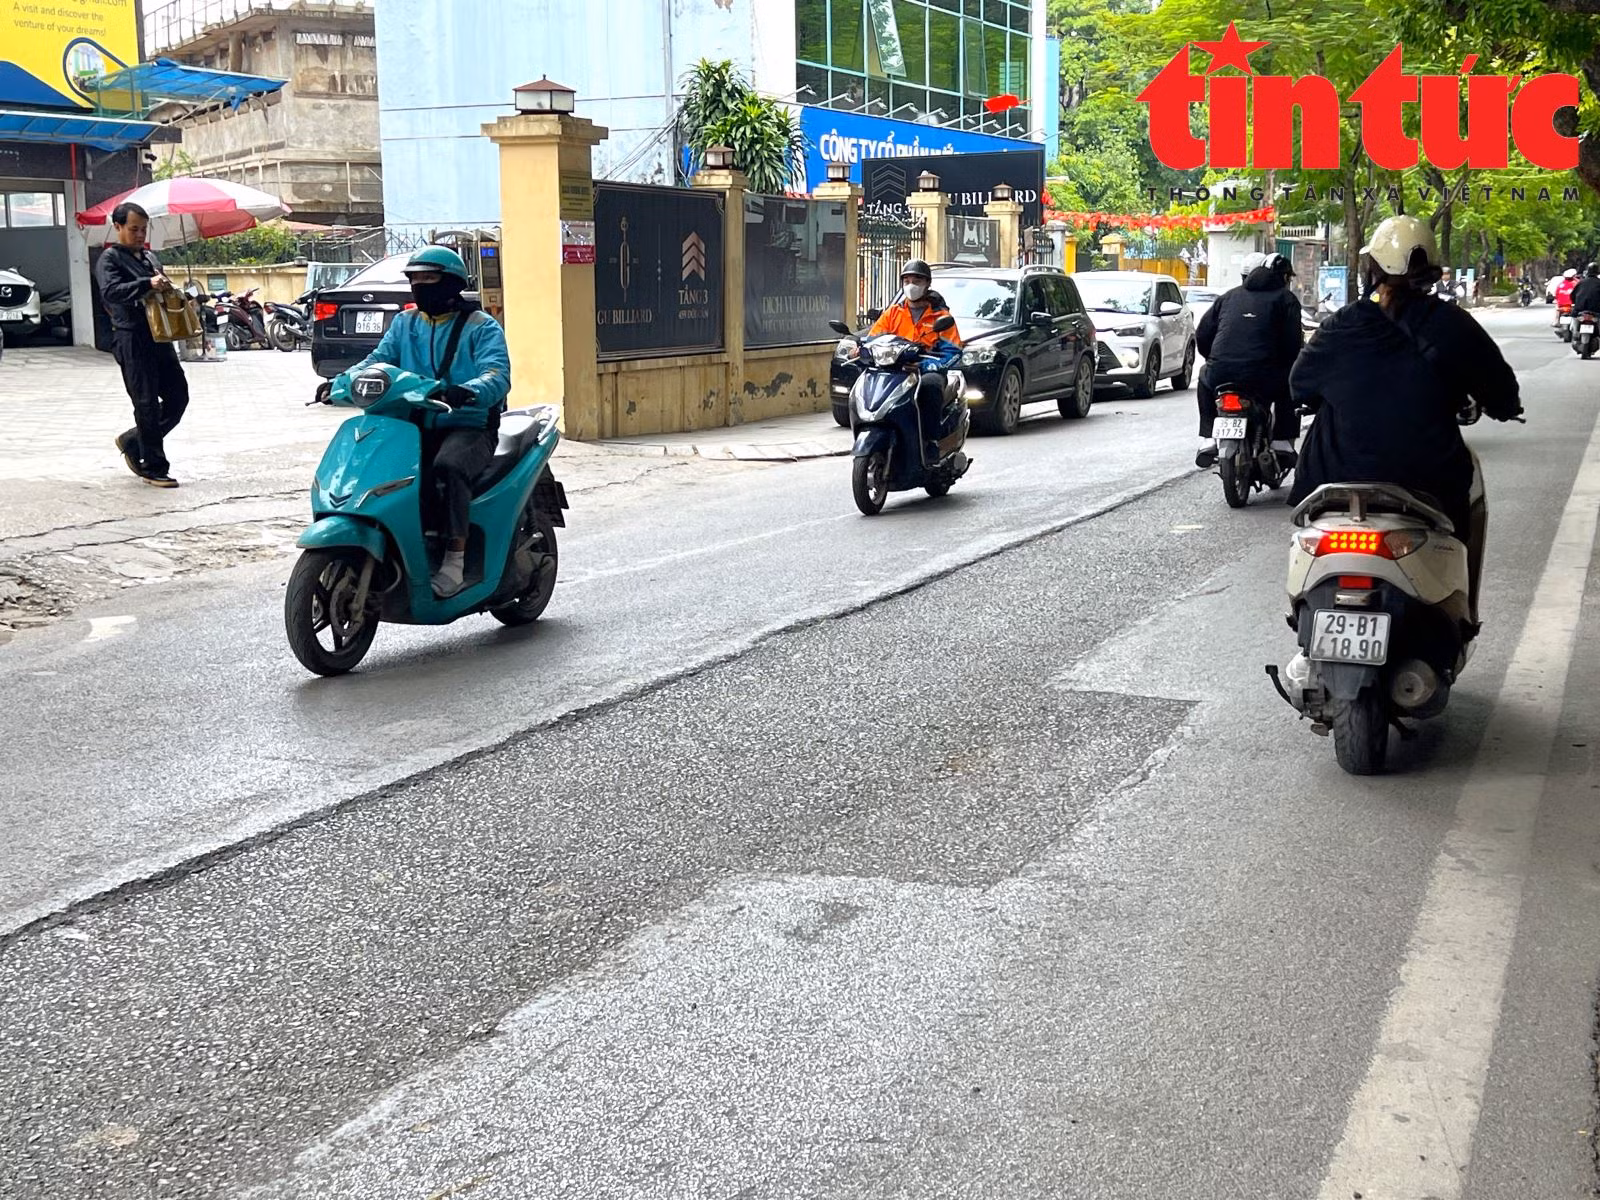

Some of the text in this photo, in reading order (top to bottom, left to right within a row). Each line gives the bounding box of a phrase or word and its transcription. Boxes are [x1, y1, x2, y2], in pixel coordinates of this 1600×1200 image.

[13, 2, 104, 21] A visit and discover the
[14, 19, 45, 30] venture
[46, 22, 55, 31] of
[57, 25, 75, 33] your
[820, 128, 858, 164] CÔNG
[859, 138, 877, 159] TY
[877, 130, 896, 158] CỔ
[961, 189, 1037, 206] BILRD
[702, 289, 709, 305] 3
[612, 309, 653, 324] BILLIARD
[1324, 614, 1378, 637] 29-B1
